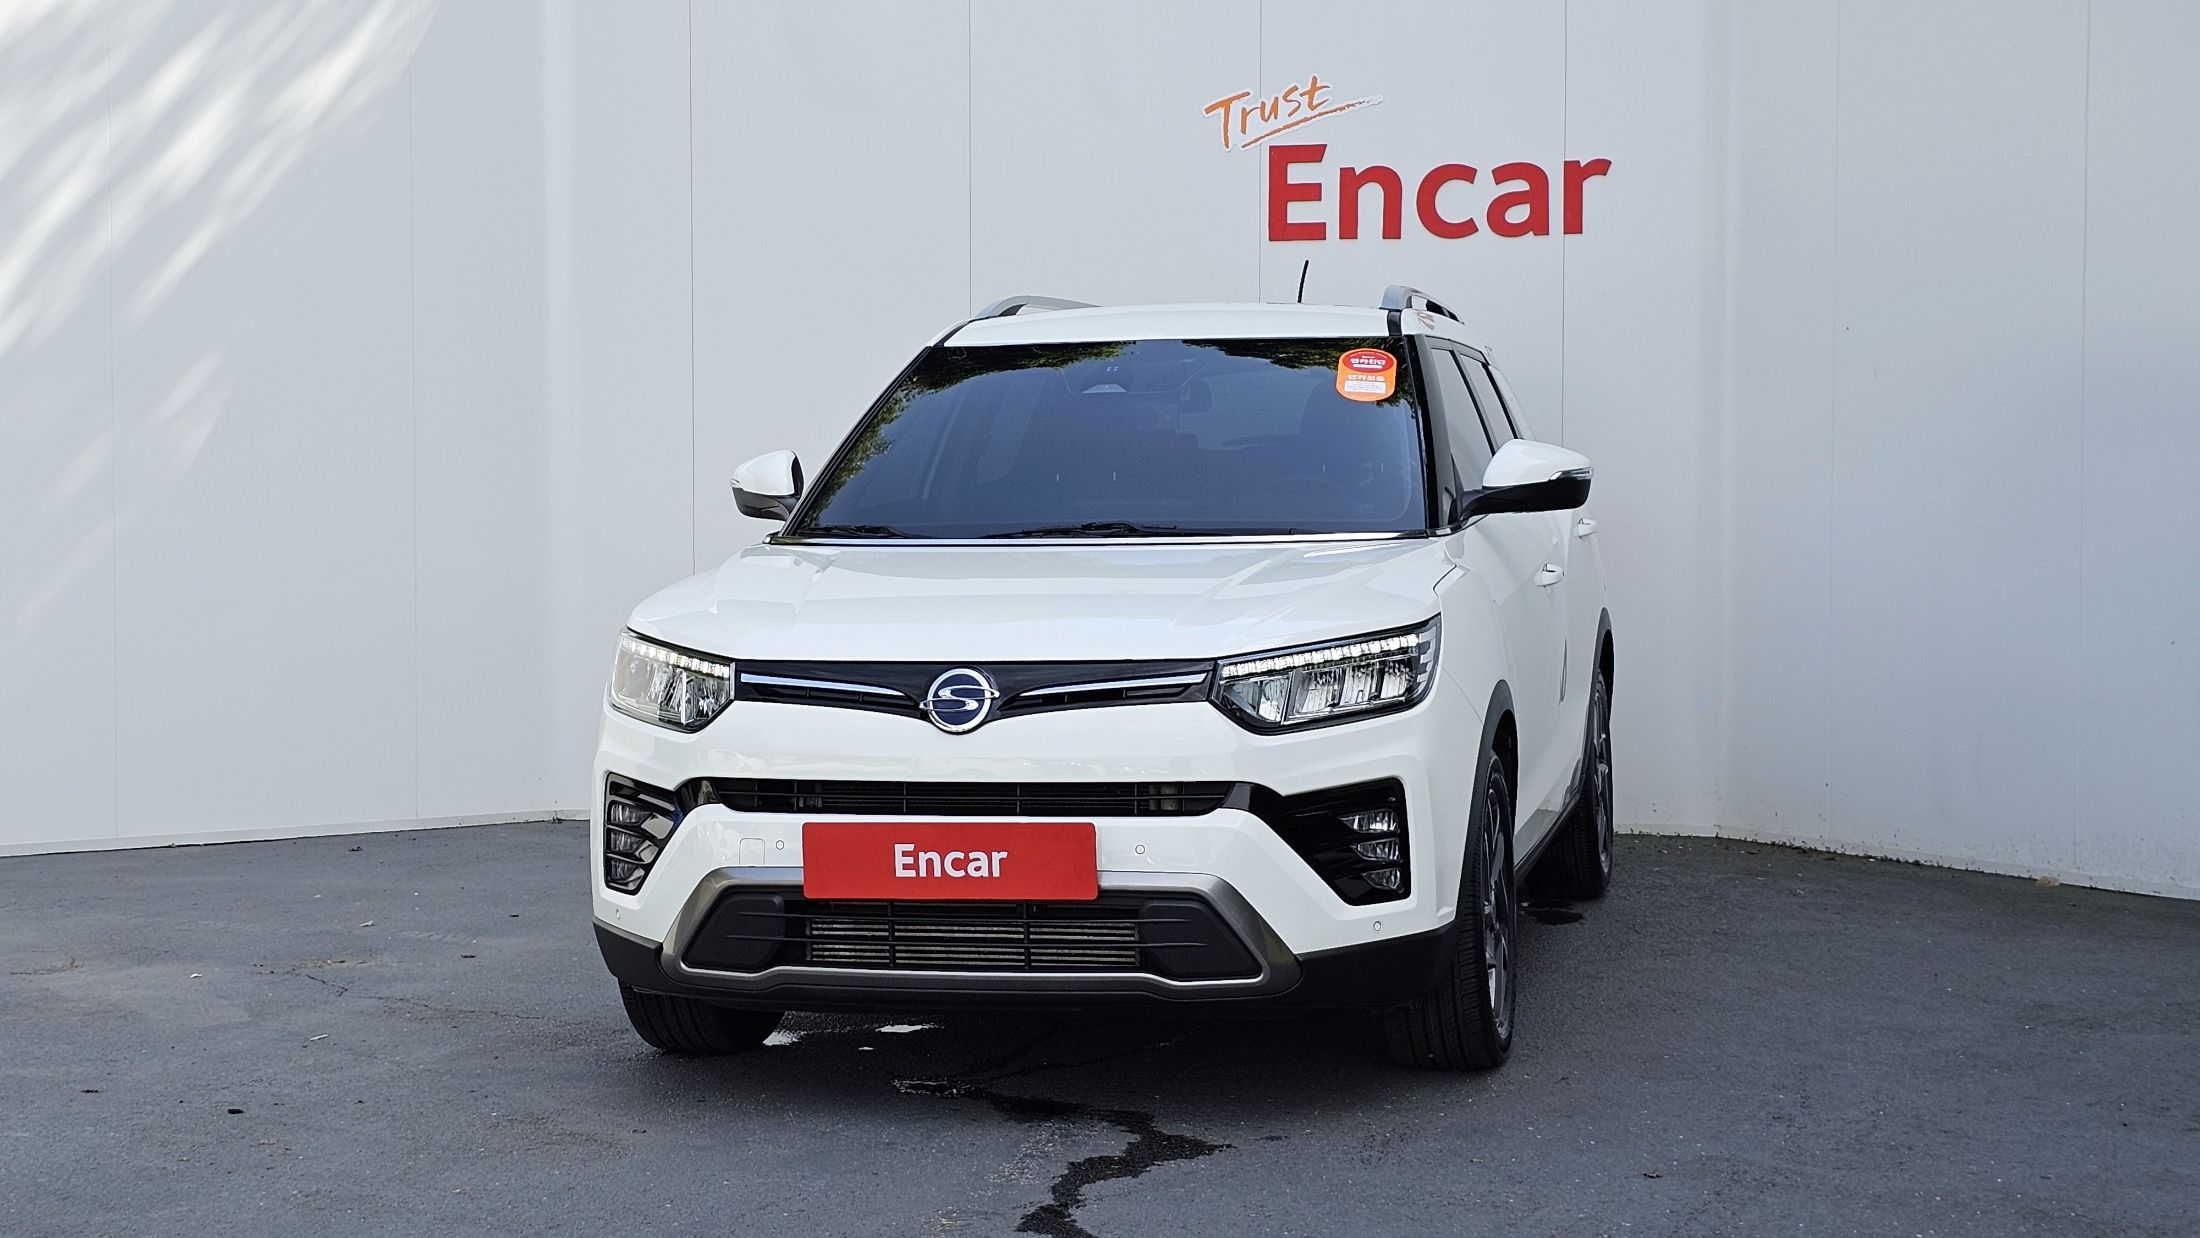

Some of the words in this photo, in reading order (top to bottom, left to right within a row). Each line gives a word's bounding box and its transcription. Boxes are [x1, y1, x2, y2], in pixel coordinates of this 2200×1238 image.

[1204, 75, 1331, 149] Trust
[1268, 144, 1612, 242] Encar
[894, 843, 1008, 878] Encar
